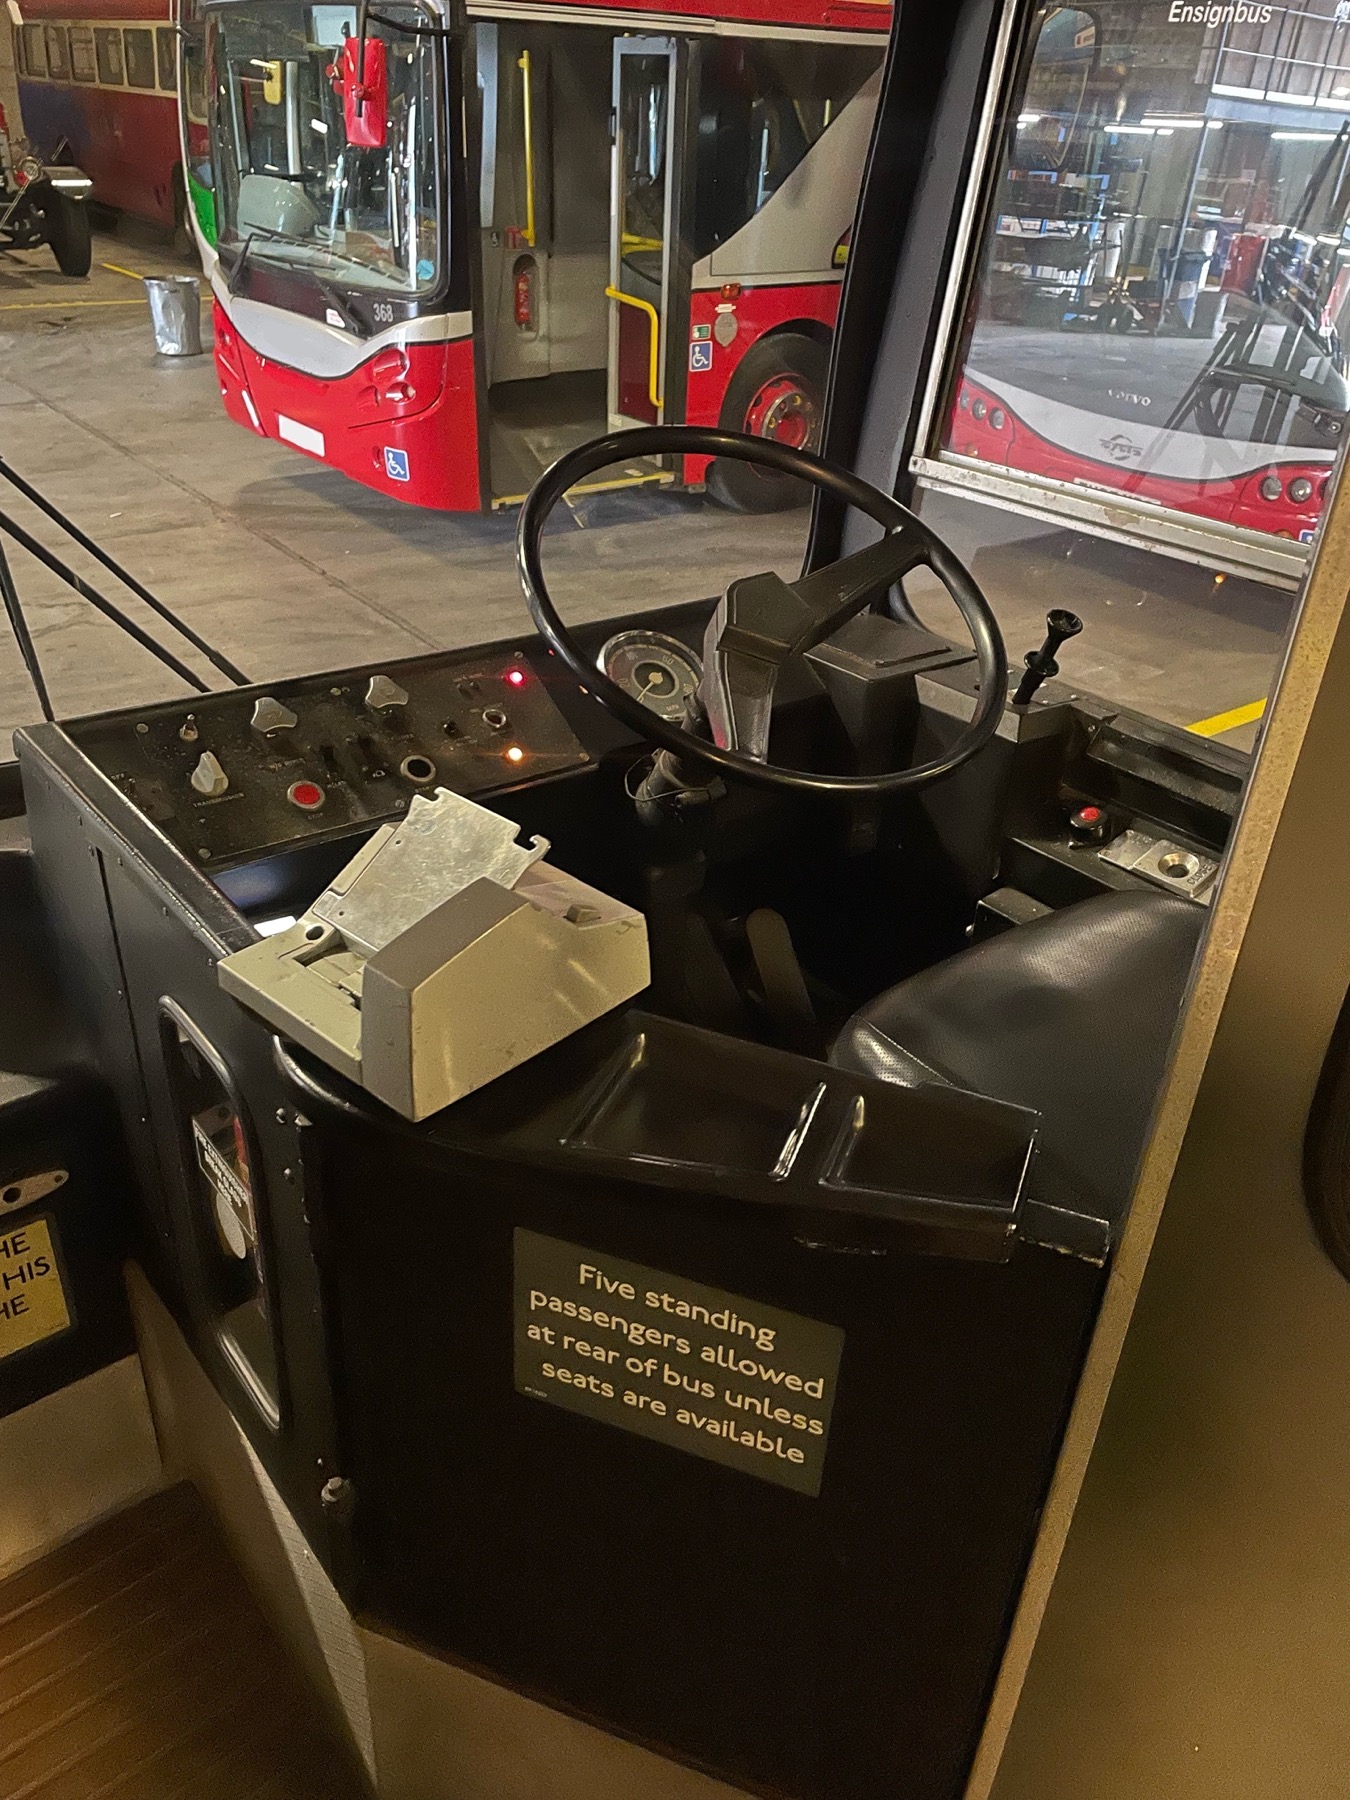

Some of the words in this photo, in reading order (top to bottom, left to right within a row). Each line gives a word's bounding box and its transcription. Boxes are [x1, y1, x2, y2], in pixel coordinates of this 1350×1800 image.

[1168, 1, 1272, 28] Ensignbus
[373, 303, 394, 322] 368
[2, 1256, 50, 1291] HIS
[578, 1263, 636, 1300] Five
[645, 1290, 776, 1352] standing
[526, 1323, 555, 1345] at
[562, 1334, 620, 1364] rear
[625, 1356, 658, 1377] of
[663, 1363, 716, 1398] bus
[724, 1389, 824, 1435] unless
[530, 1289, 691, 1354] passengers
[701, 1345, 825, 1399] allowed
[541, 1362, 615, 1398] seats
[623, 1389, 667, 1416] are
[676, 1408, 805, 1464] available
